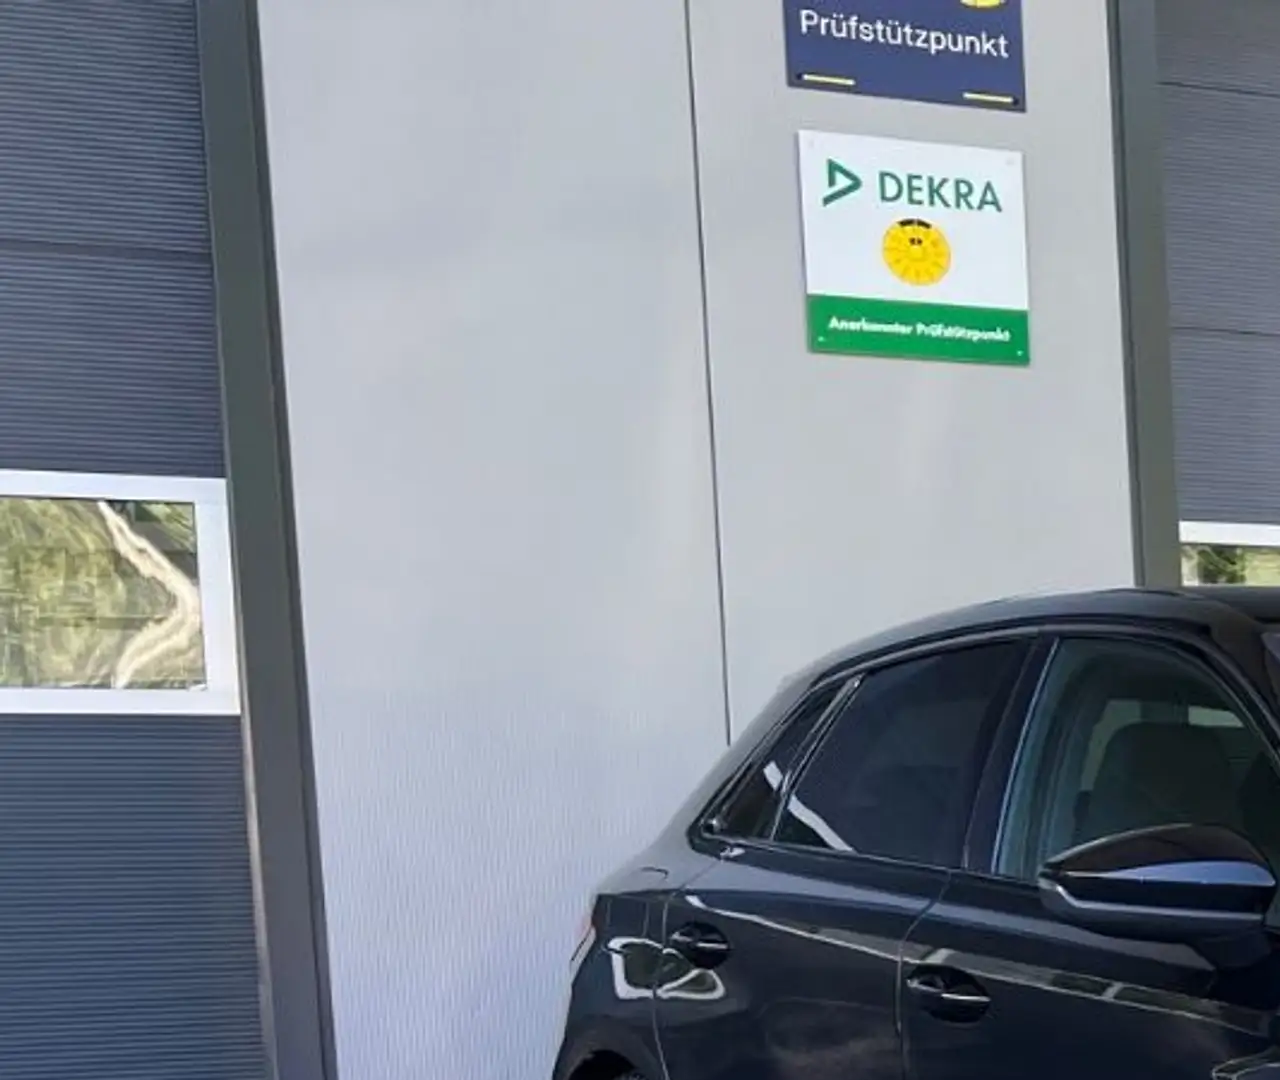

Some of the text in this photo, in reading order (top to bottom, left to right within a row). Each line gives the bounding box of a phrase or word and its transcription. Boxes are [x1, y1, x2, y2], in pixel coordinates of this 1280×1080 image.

[800, 9, 1009, 58] Prüfstützpunkt
[877, 171, 1002, 213] DEKRA
[828, 316, 1011, 342] Anerkannter Prüfstützpunkt
